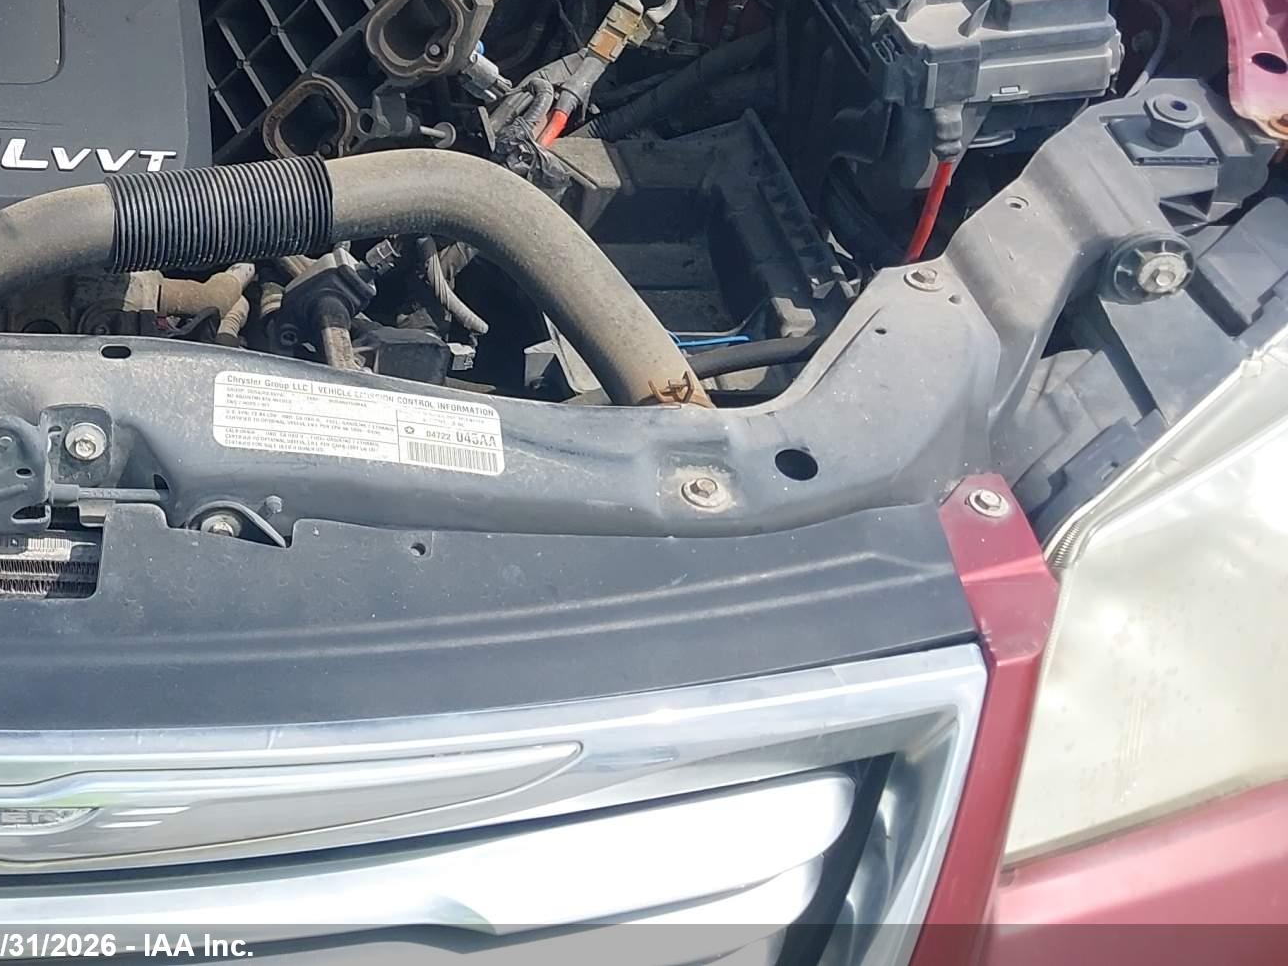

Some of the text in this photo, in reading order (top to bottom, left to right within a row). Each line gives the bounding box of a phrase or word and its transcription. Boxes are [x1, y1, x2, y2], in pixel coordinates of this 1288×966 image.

[51, 146, 177, 172] VVT
[227, 375, 261, 386] Chrysler
[265, 379, 290, 391] Group
[292, 382, 308, 392] LLC
[318, 386, 352, 398] VEHICLE
[396, 396, 434, 409] CONTROL
[437, 402, 494, 417] INFORMATION
